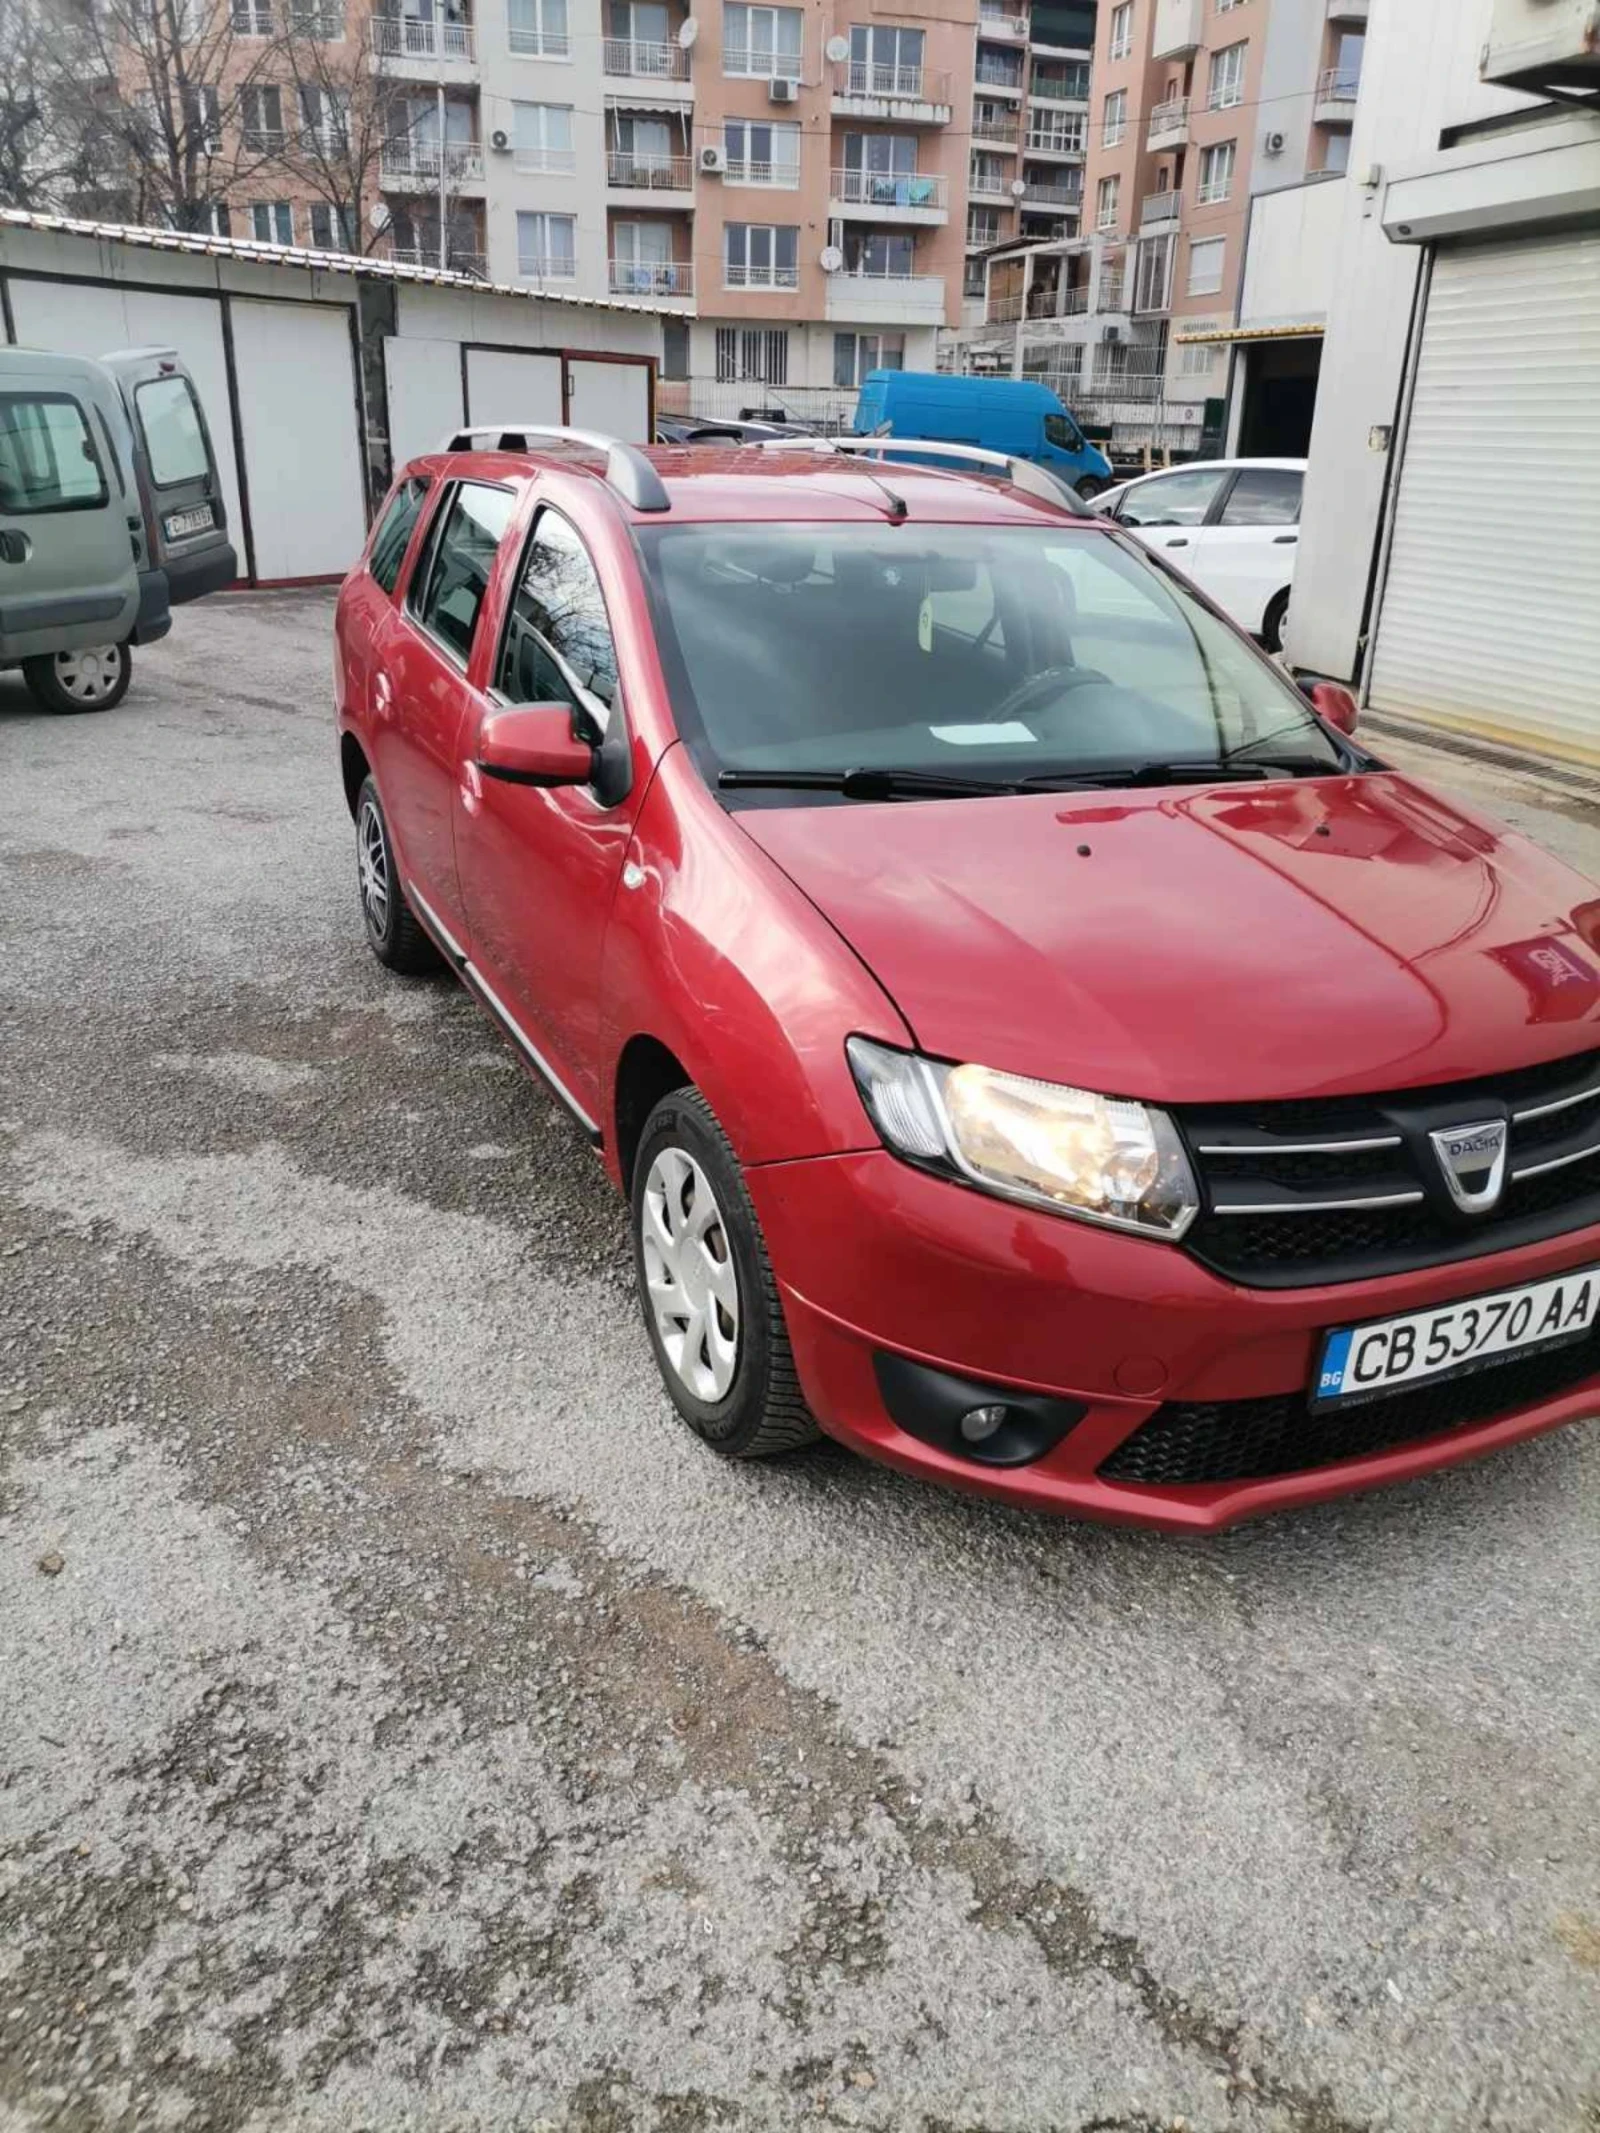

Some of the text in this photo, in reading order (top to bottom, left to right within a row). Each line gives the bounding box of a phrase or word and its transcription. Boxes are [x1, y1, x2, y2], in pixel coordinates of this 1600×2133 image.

[1450, 1136, 1500, 1156] DACIA
[1353, 1280, 1592, 1382] CB 5370 AA
[1320, 1373, 1341, 1388] BG
